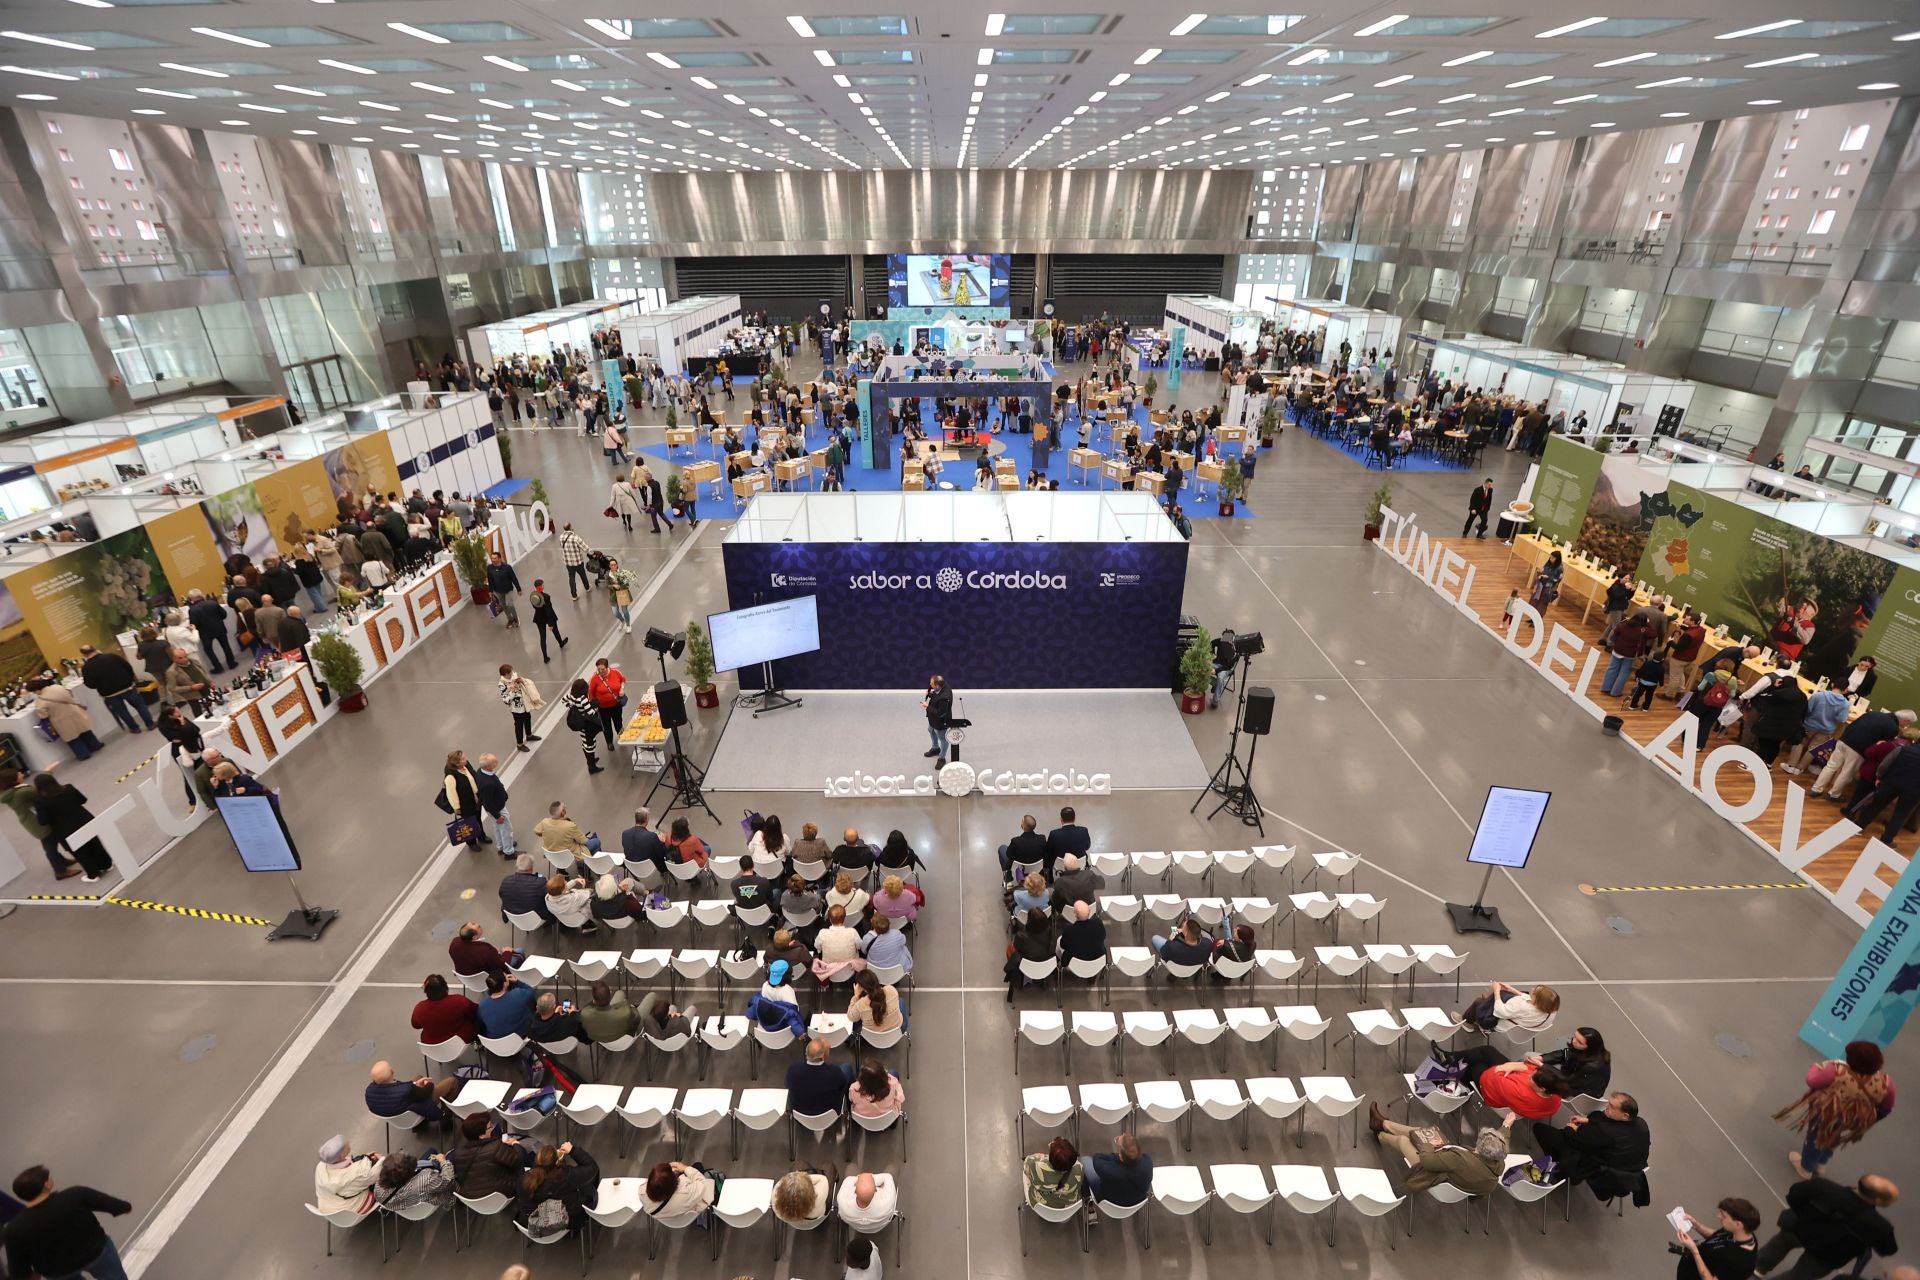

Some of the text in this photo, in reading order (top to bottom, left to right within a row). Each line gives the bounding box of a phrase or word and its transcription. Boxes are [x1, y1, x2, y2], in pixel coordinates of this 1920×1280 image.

[374, 571, 471, 667] DEL
[850, 570, 1067, 590] sabor a Córdoba
[1378, 503, 1480, 624] TÚNEL
[1504, 598, 1607, 721] DEL
[1640, 710, 1912, 931] AOVE
[825, 768, 1112, 795] sabor a Córdoba
[1831, 878, 1920, 1021] NA EXHIBICIONES
